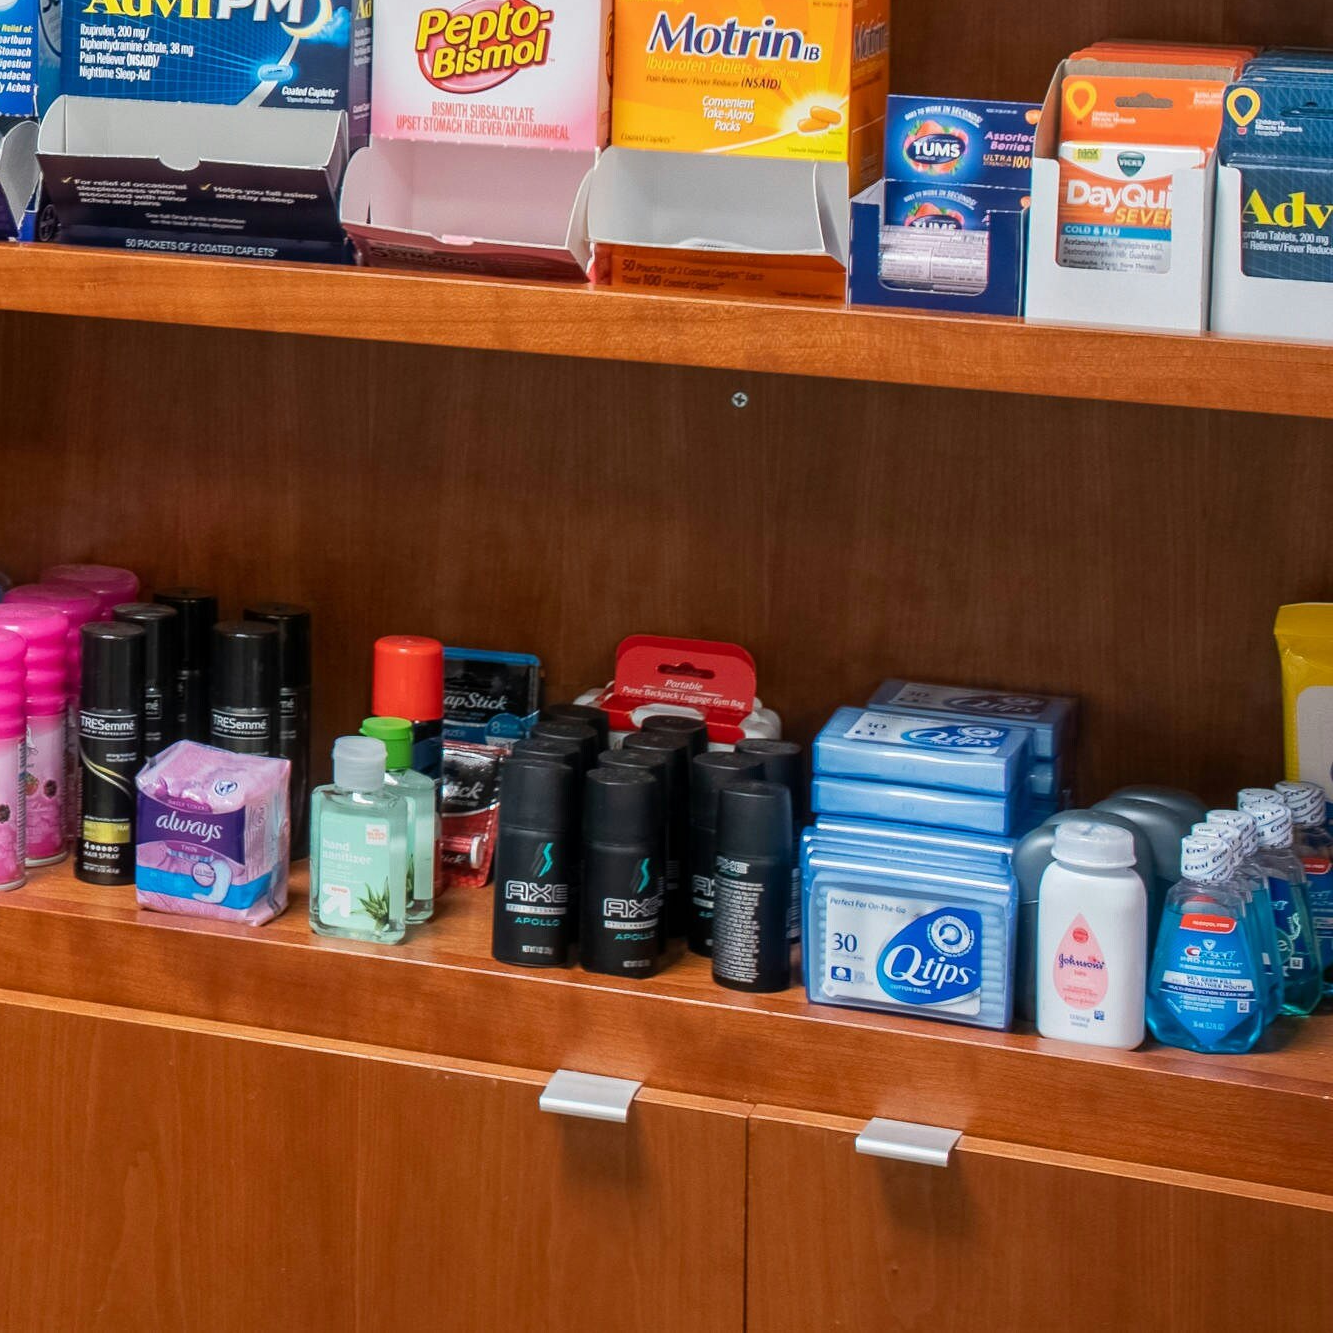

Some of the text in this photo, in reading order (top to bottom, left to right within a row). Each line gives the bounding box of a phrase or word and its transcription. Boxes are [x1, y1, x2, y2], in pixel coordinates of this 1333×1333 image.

[118, 26, 131, 37] 200
[416, 2, 552, 50] Pepto-
[647, 12, 804, 61] Motrin
[80, 52, 94, 64] Pain
[181, 45, 193, 56] mg
[432, 30, 547, 79] Bismol
[6, 82, 31, 93] Aches
[702, 96, 754, 109] Convenient
[432, 101, 534, 122] BISMUTH SUBSALICYLATE
[703, 108, 754, 123] Take-Along
[397, 115, 463, 133] UPSET STOMACH
[714, 120, 741, 132] Packs
[913, 141, 960, 158] TUMS
[991, 141, 1030, 152] Berries
[1067, 179, 1172, 214] DayQui
[1065, 226, 1120, 236] COLD FLU
[137, 240, 177, 250] PACKETS
[199, 243, 234, 253] COATED
[1300, 233, 1329, 245] 200 mg
[156, 811, 223, 842] always
[506, 881, 568, 903] AXE
[515, 916, 560, 926] APOLLO
[833, 932, 857, 952] 30
[884, 944, 974, 989] Q-tips
